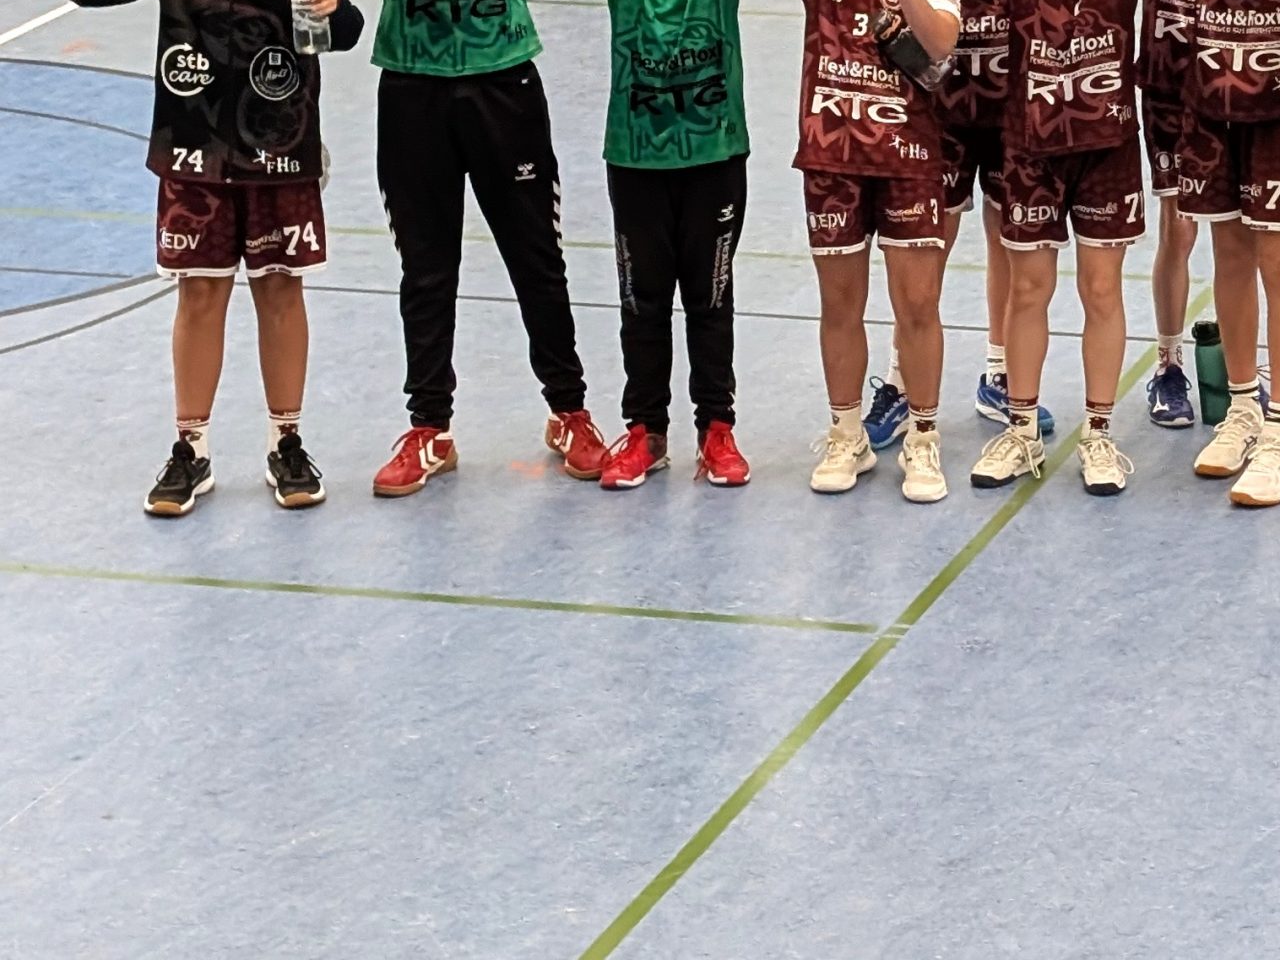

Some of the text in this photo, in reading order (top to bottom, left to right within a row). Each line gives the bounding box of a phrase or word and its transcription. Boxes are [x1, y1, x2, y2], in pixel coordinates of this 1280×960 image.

[852, 13, 869, 36] 3
[176, 51, 211, 71] stb
[168, 67, 216, 86] care
[1027, 70, 1122, 106] KTG
[630, 76, 728, 115] KTG
[810, 91, 909, 124] KTG
[171, 147, 204, 173] 74
[817, 211, 848, 229] EDV
[930, 198, 938, 225] 3
[164, 233, 201, 250] EDV
[283, 221, 320, 256] 74
